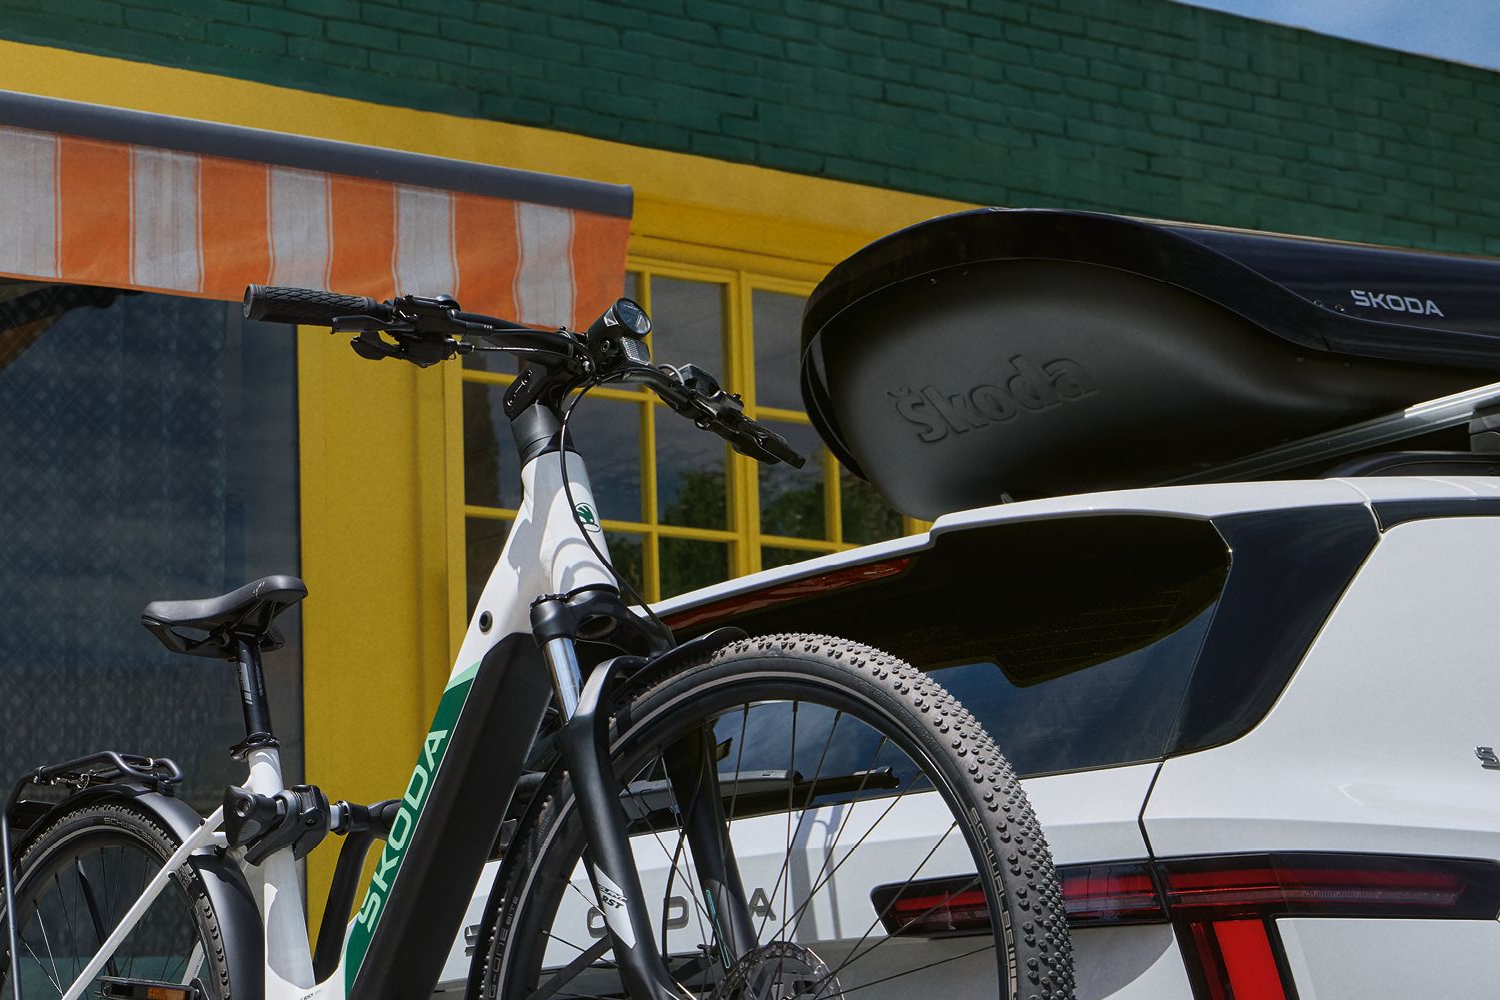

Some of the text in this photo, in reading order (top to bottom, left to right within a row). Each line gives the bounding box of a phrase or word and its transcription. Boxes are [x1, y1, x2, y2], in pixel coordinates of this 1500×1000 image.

[887, 355, 1098, 443] Škoda
[357, 729, 449, 933] SKODA
[969, 807, 1014, 945] SCHWALBE
[602, 895, 625, 910] RST
